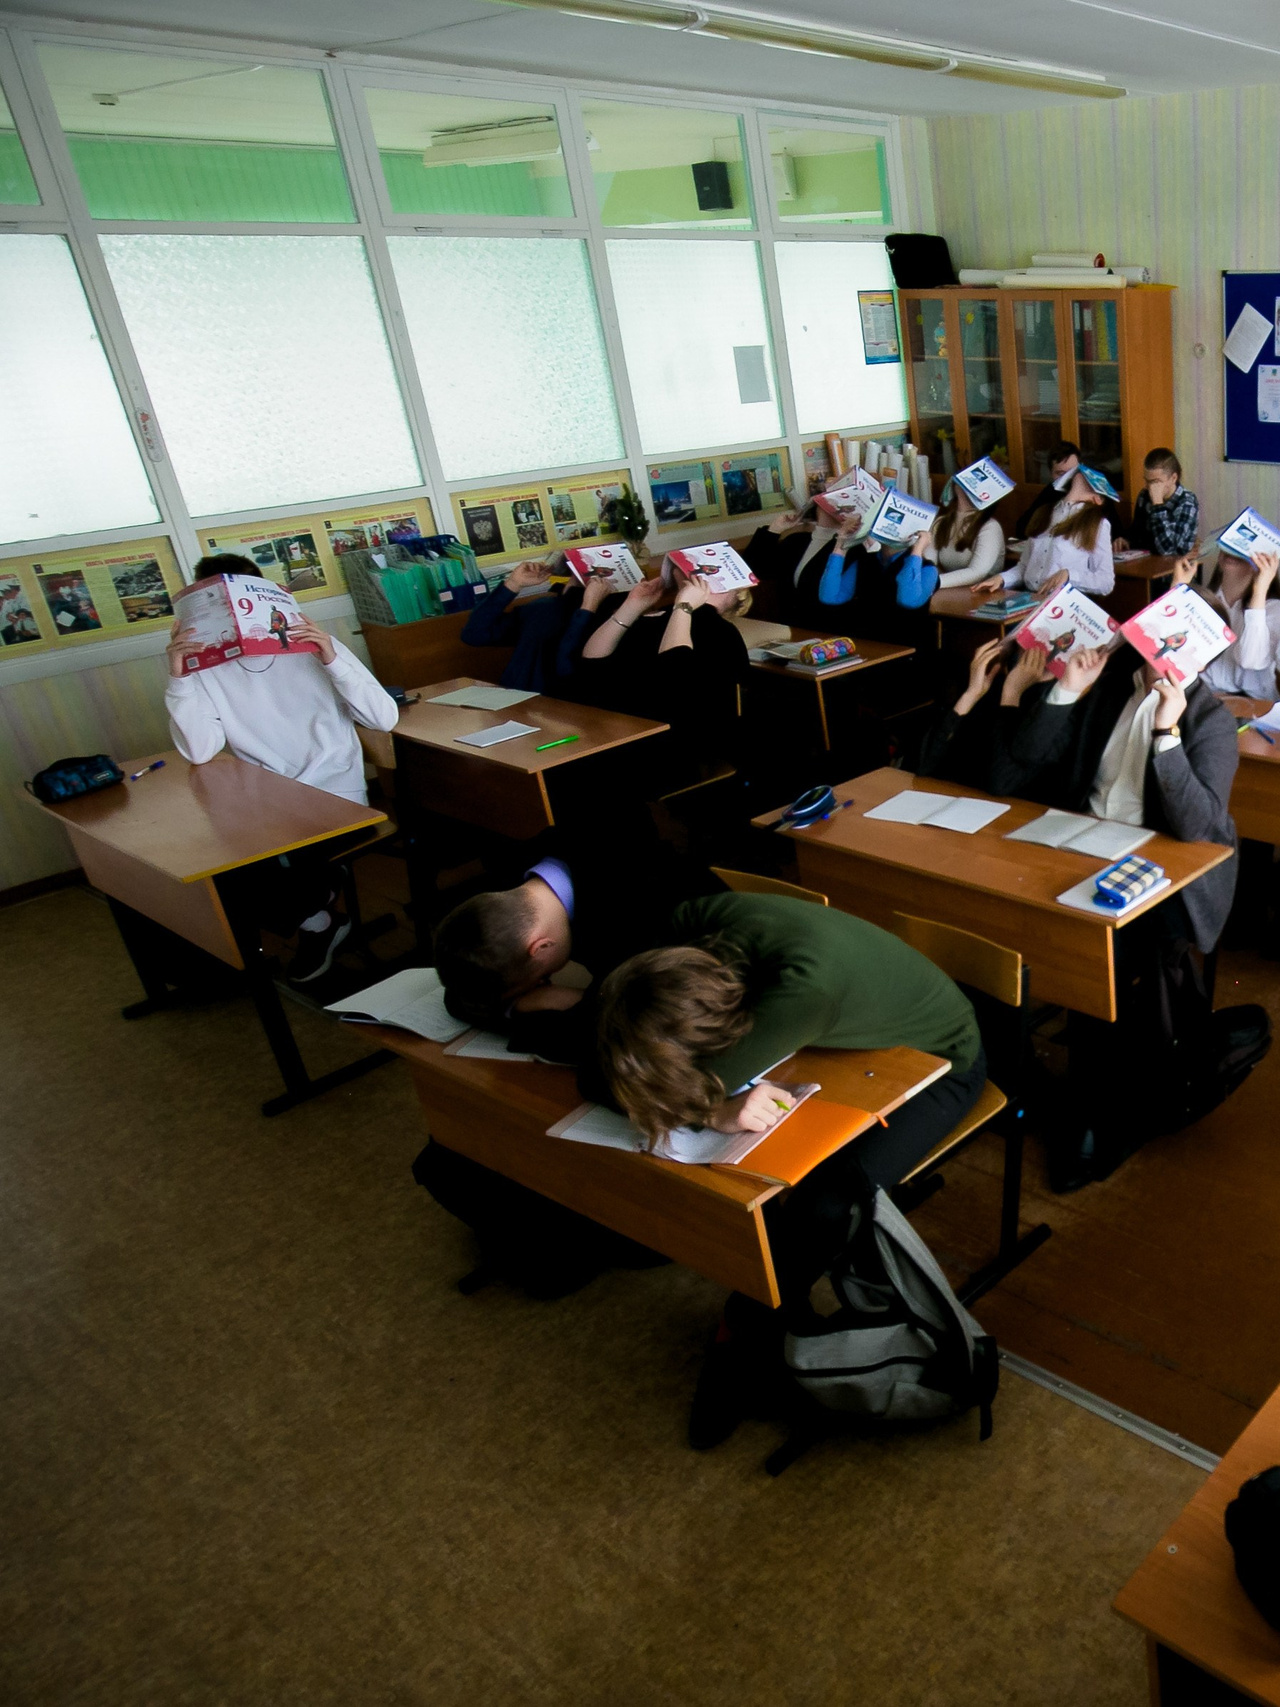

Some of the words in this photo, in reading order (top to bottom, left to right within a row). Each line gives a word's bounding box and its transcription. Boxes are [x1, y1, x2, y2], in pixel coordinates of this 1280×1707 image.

[980, 491, 990, 500] 9
[889, 496, 928, 520] Химия
[595, 549, 612, 559] 9
[700, 548, 716, 556] 9
[244, 584, 289, 599] История
[237, 597, 254, 617] 9
[256, 594, 292, 606] России
[1045, 606, 1064, 620] 9
[1069, 602, 1106, 634] История
[1160, 604, 1177, 618] 9
[1069, 613, 1100, 641] России
